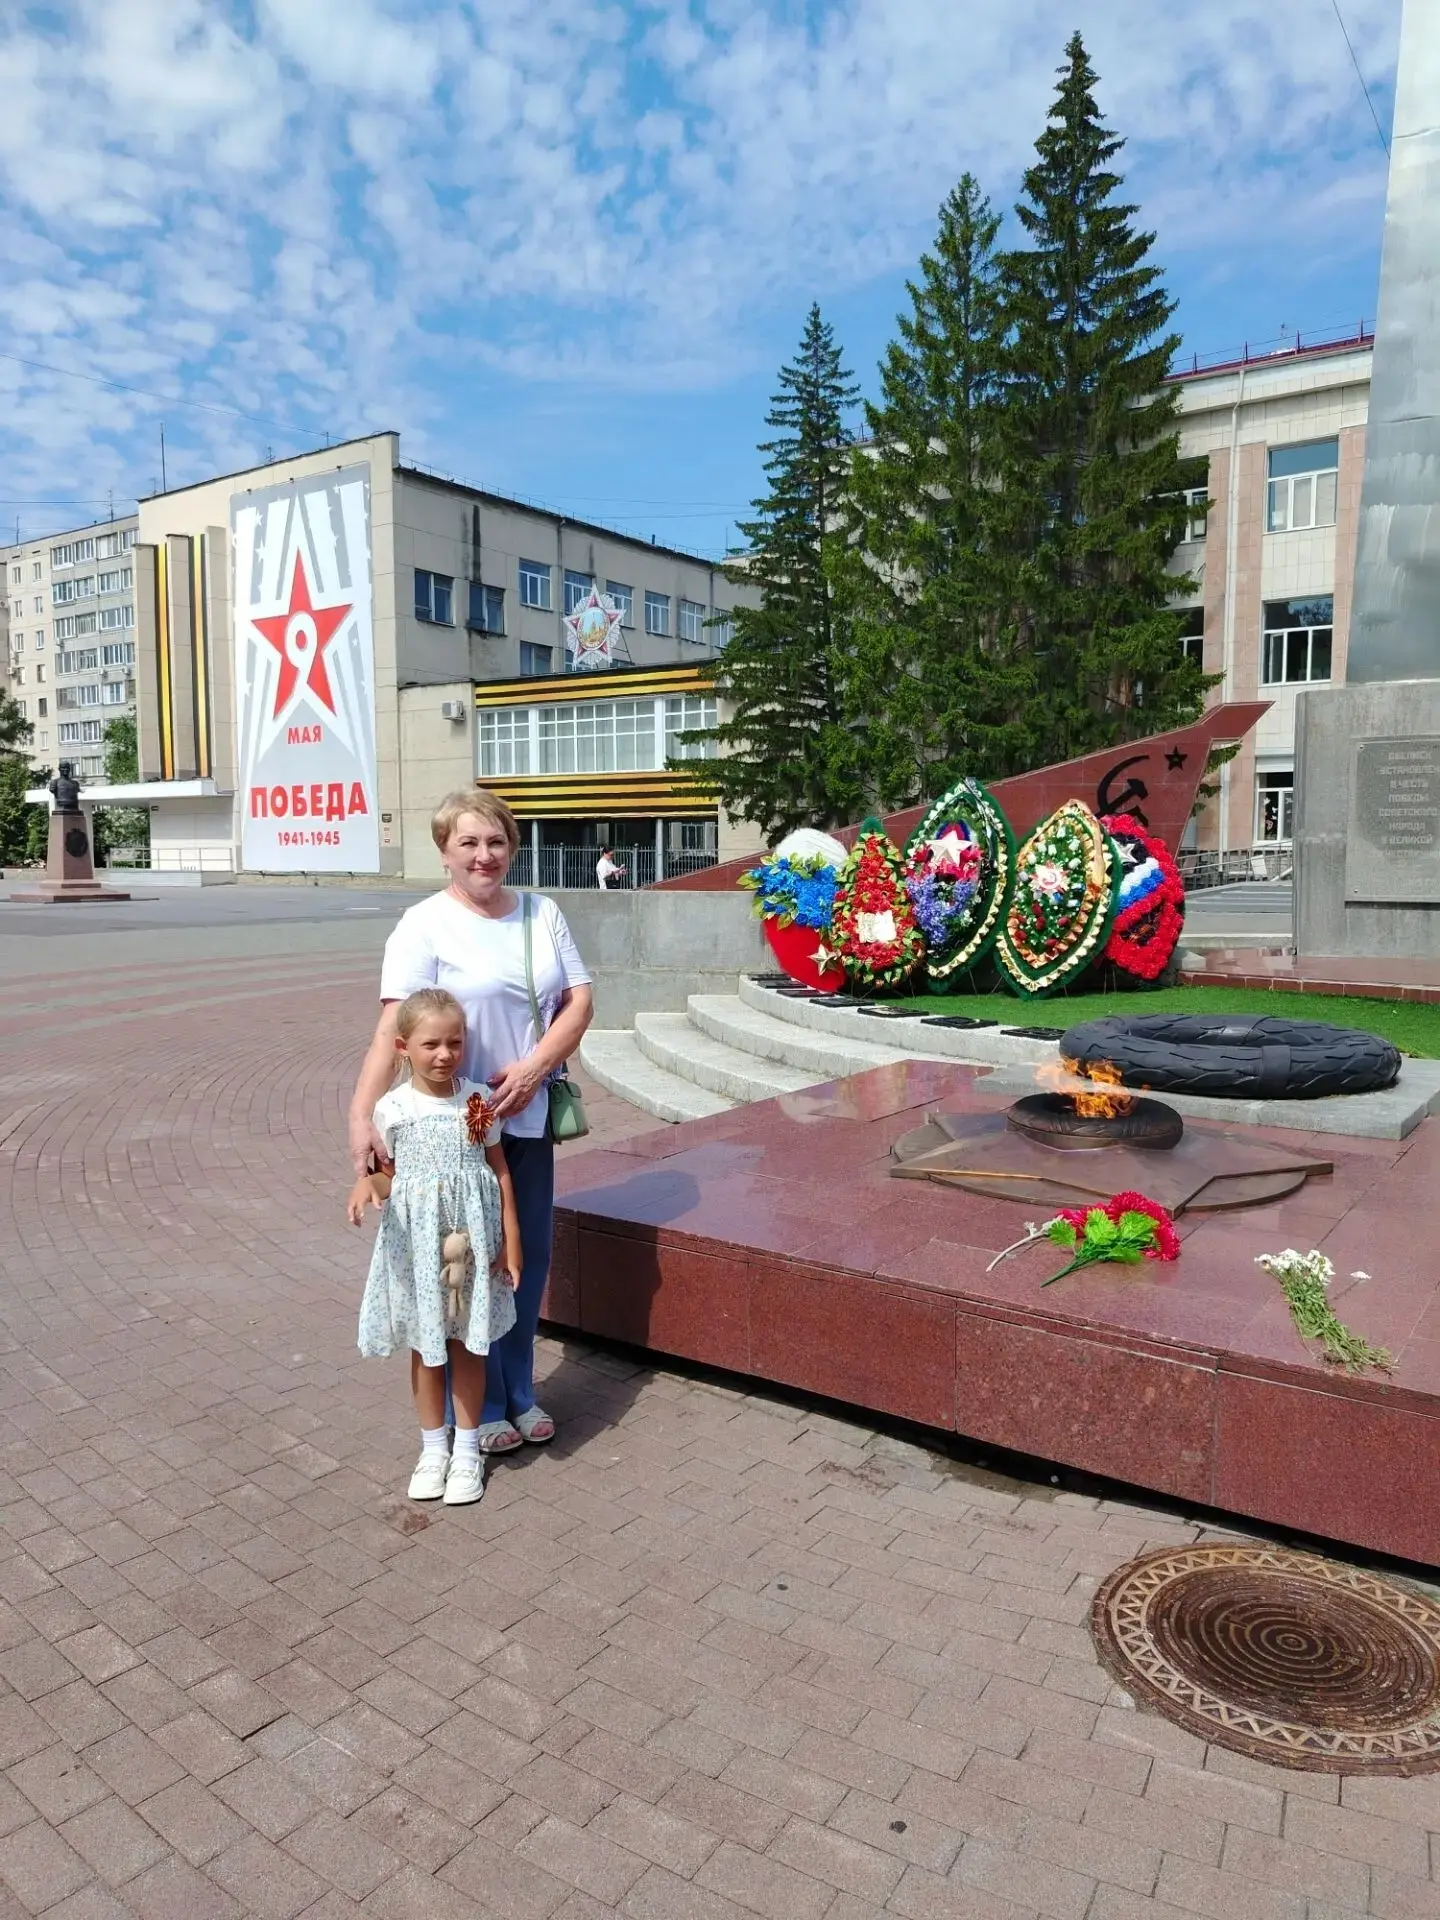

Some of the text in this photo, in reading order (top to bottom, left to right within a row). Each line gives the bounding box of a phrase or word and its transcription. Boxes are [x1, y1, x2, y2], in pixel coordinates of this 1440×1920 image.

[283, 610, 318, 697] 9
[287, 725, 322, 744] МАЯ
[251, 782, 368, 822] ПОБЕДА
[278, 831, 340, 846] 1941-1945
